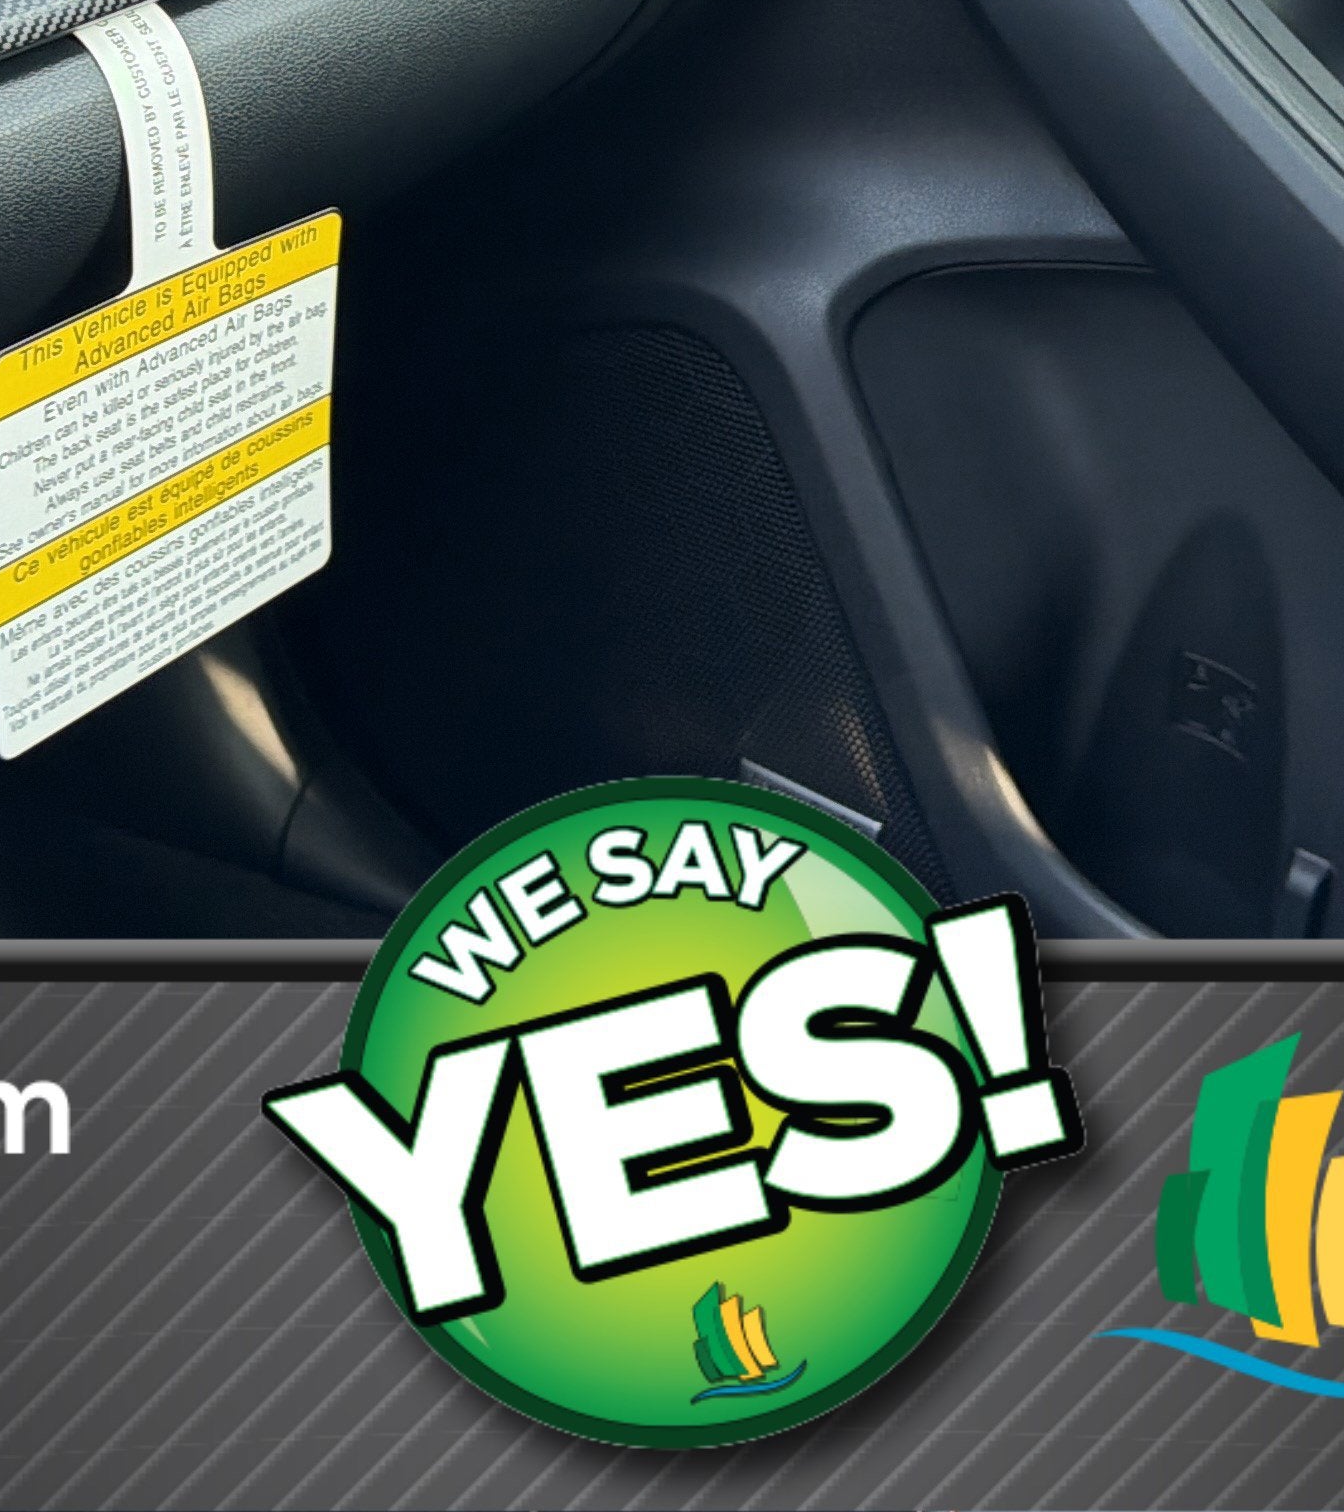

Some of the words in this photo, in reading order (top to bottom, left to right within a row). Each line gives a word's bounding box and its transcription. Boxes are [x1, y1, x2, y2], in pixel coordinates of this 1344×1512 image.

[142, 104, 156, 123] BY
[164, 88, 181, 107] LE
[146, 126, 165, 196] REMOVED
[154, 198, 167, 218] BE
[154, 221, 168, 242] TO
[19, 338, 63, 371] This
[72, 300, 147, 344] Vehicle
[155, 286, 173, 309] is
[181, 244, 272, 296] Equipped
[279, 225, 318, 253] with
[73, 307, 175, 374] Advanced
[182, 295, 211, 325] Air
[218, 273, 266, 311] Bags
[42, 389, 88, 423] Even
[93, 367, 130, 397] with
[137, 323, 218, 376] Advanced
[223, 312, 247, 336] Air
[252, 293, 293, 323] Bags
[11, 558, 40, 583] Ce
[46, 514, 120, 564] véhicule
[126, 493, 154, 522] est
[159, 459, 215, 504] équipé
[219, 449, 241, 471] de
[246, 410, 314, 457] coussins
[78, 512, 168, 576] gonflables
[172, 461, 259, 519] intelligents
